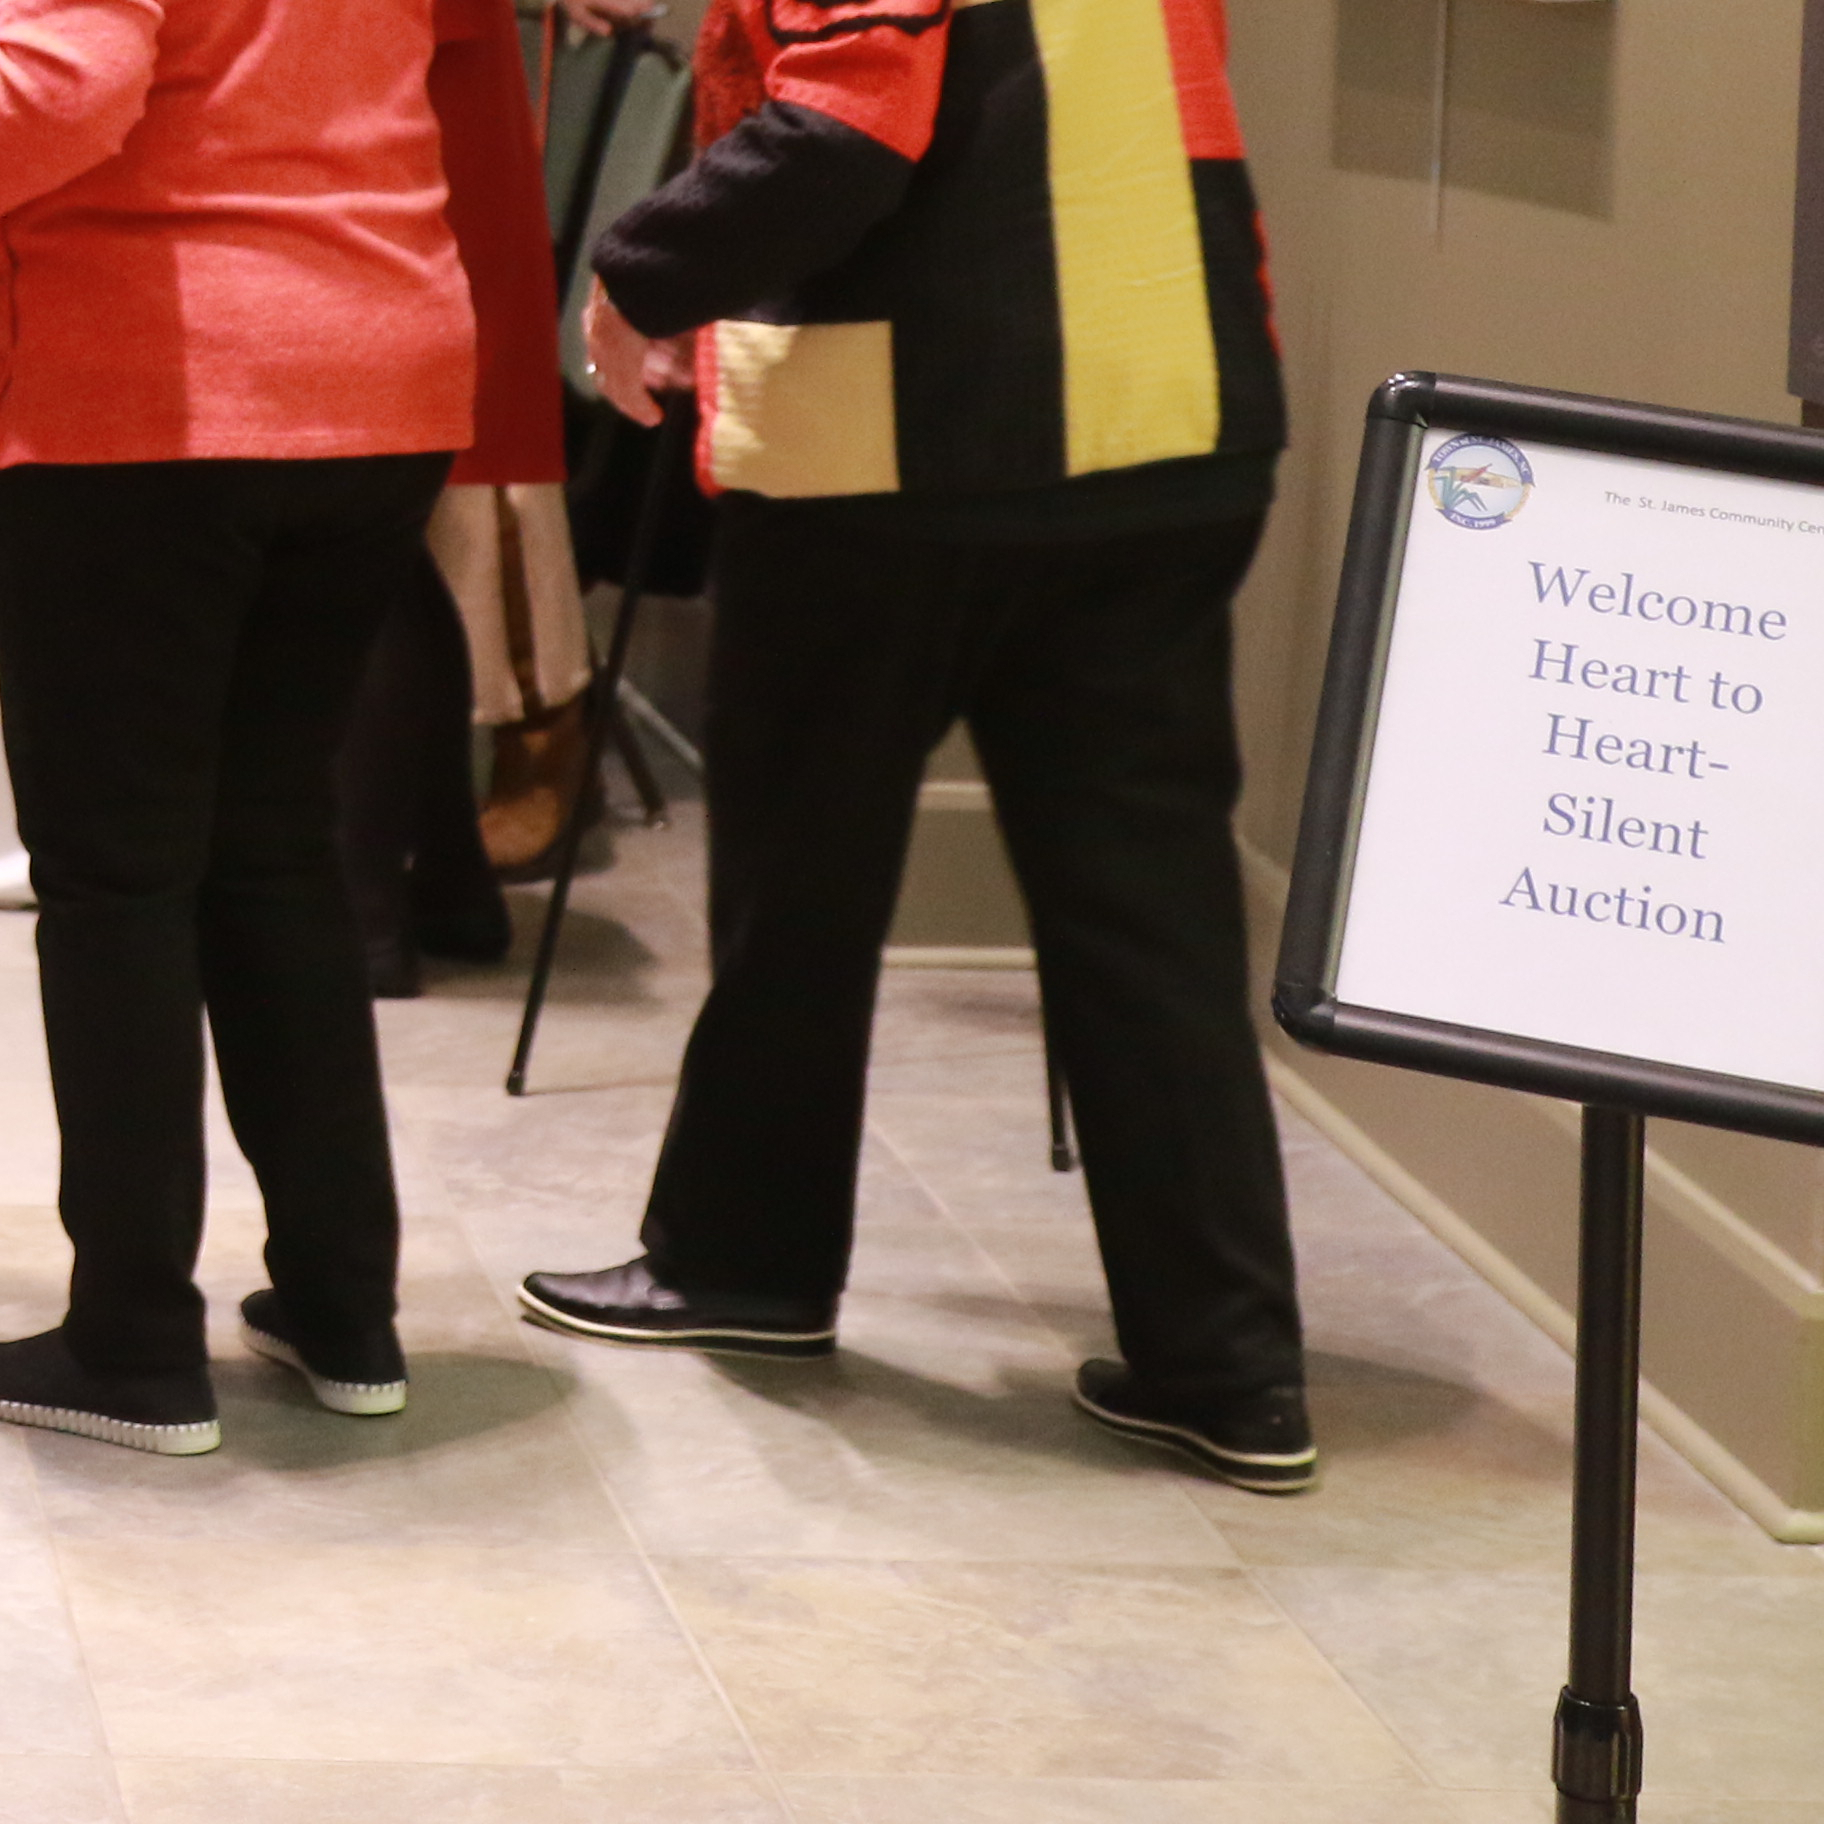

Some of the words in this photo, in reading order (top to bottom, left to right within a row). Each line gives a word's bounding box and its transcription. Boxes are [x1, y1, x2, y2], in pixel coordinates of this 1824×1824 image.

[1605, 491, 1631, 506] The
[1638, 496, 1656, 510] St.
[1661, 500, 1706, 517] James
[1709, 507, 1795, 532] Community
[1527, 560, 1787, 641] Welcome
[1528, 638, 1692, 703] Heart
[1708, 671, 1763, 714] to
[1542, 712, 1729, 779] Heart-
[1543, 792, 1709, 859] Silent
[1498, 866, 1725, 943] Auction
